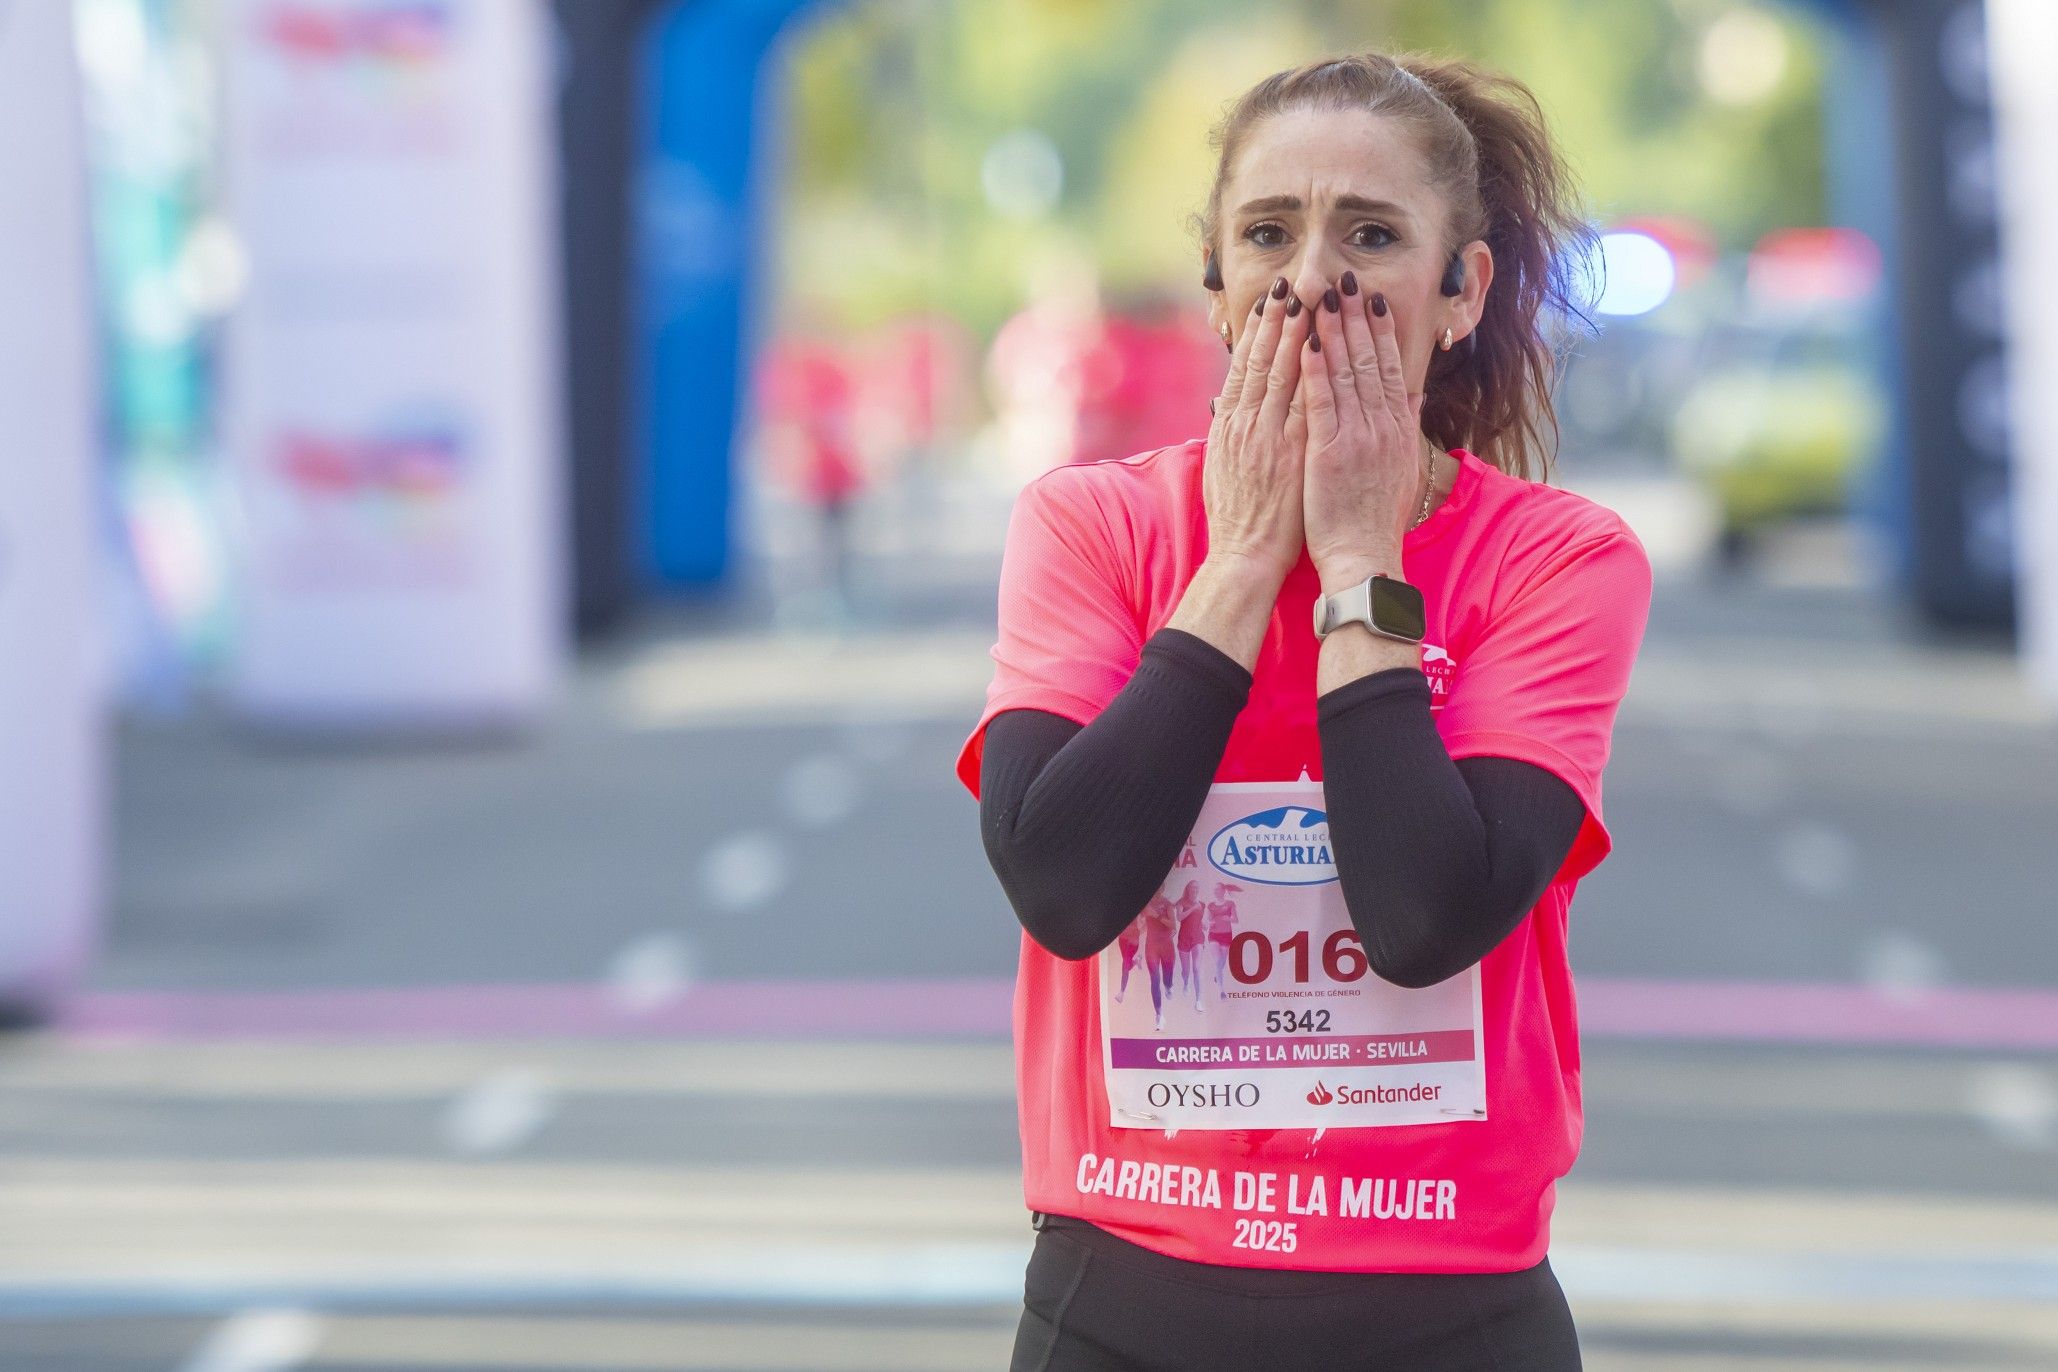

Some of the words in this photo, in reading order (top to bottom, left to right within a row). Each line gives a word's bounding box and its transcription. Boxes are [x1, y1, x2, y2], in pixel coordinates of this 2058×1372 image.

[1246, 833, 1298, 841] CENTRAL
[1304, 833, 1331, 841] LEC
[1220, 835, 1336, 865] ASTURIA
[1228, 929, 1368, 985] 016
[1227, 990, 1270, 999] TELÉFONO
[1272, 990, 1313, 998] VIOLENCIA
[1327, 989, 1361, 997] GÉNERO
[1266, 1009, 1331, 1033] 5342
[1155, 1046, 1233, 1063] CARRERA
[1238, 1045, 1260, 1062] DE
[1266, 1044, 1287, 1061] LA
[1292, 1043, 1350, 1061] MUJER
[1366, 1040, 1428, 1059] SEVILLA
[1147, 1083, 1260, 1108] OYSHO
[1337, 1082, 1442, 1105] Santander
[1076, 1153, 1221, 1209] CARRERA
[1234, 1172, 1277, 1212] DE
[1288, 1174, 1327, 1216] LA
[1339, 1177, 1457, 1220] MUJER
[1232, 1218, 1297, 1253] 2025
